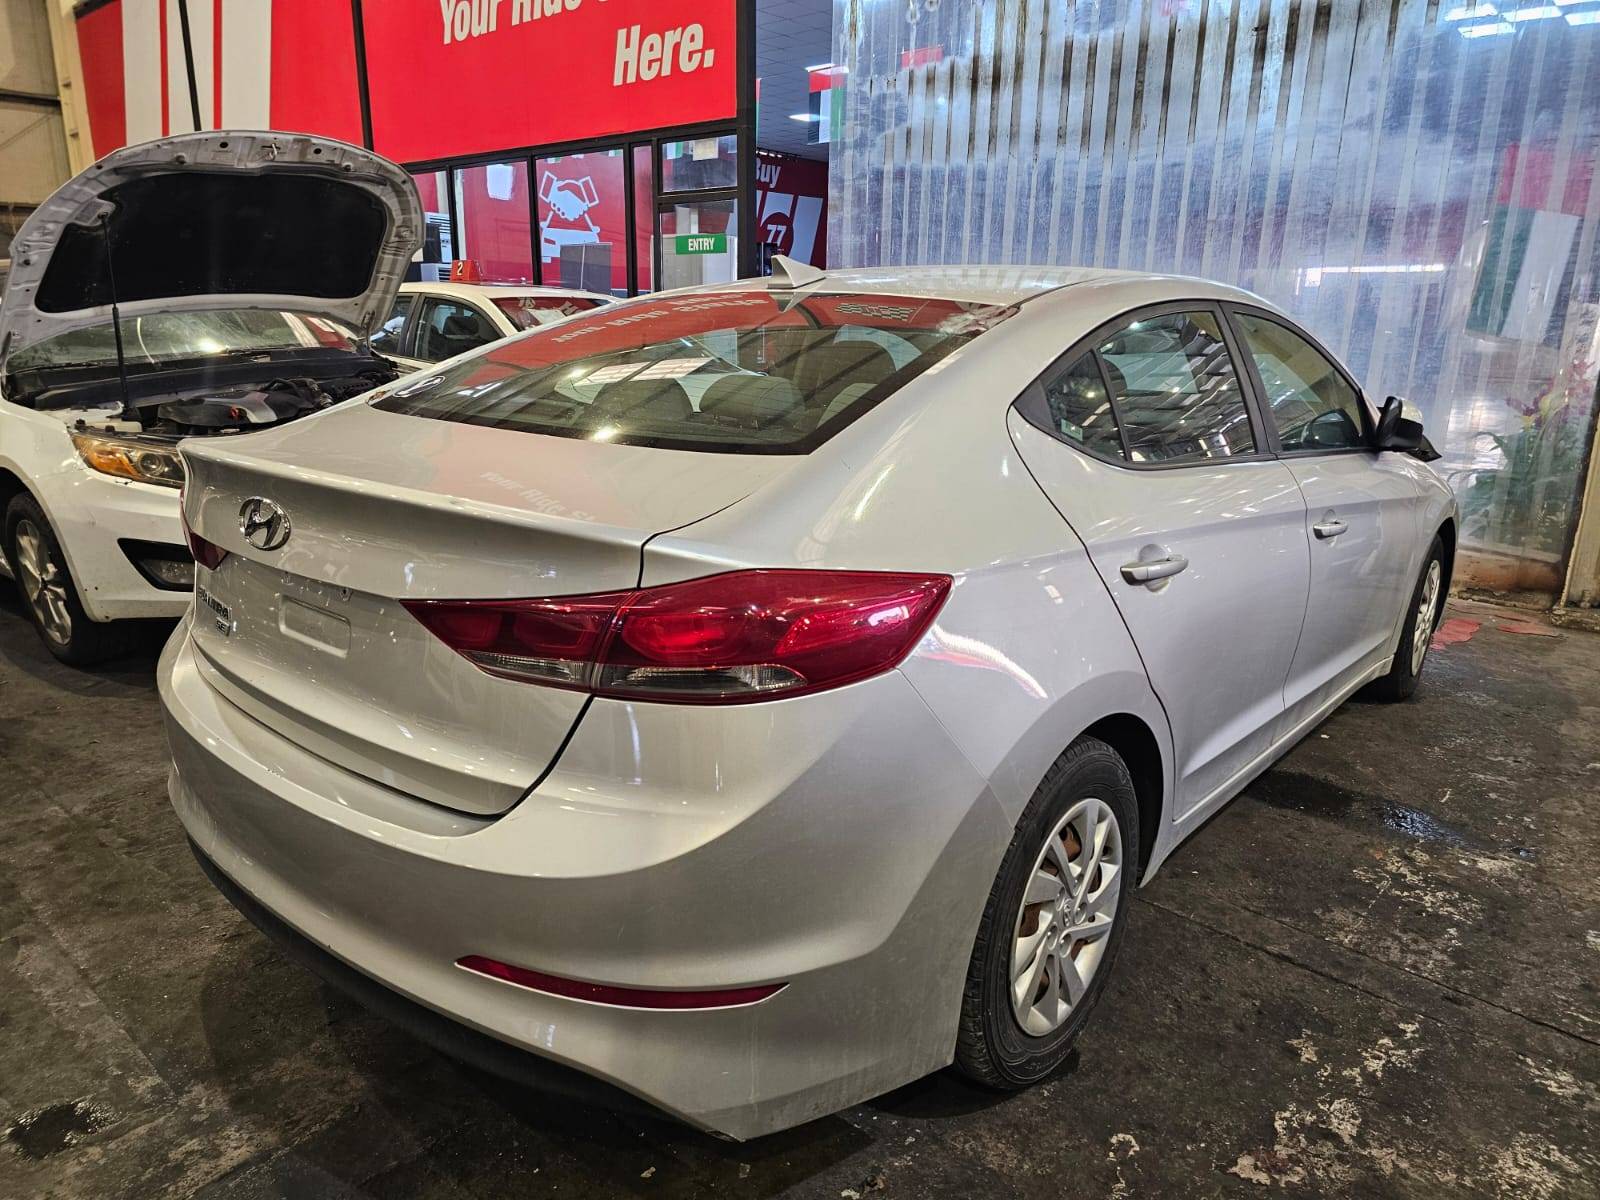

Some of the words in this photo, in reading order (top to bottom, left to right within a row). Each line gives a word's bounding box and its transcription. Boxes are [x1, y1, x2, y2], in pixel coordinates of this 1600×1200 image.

[440, 0, 502, 45] Your
[613, 23, 715, 87] Here.
[688, 237, 715, 251] ENTRY
[766, 224, 787, 247] 77
[456, 261, 464, 276] 2
